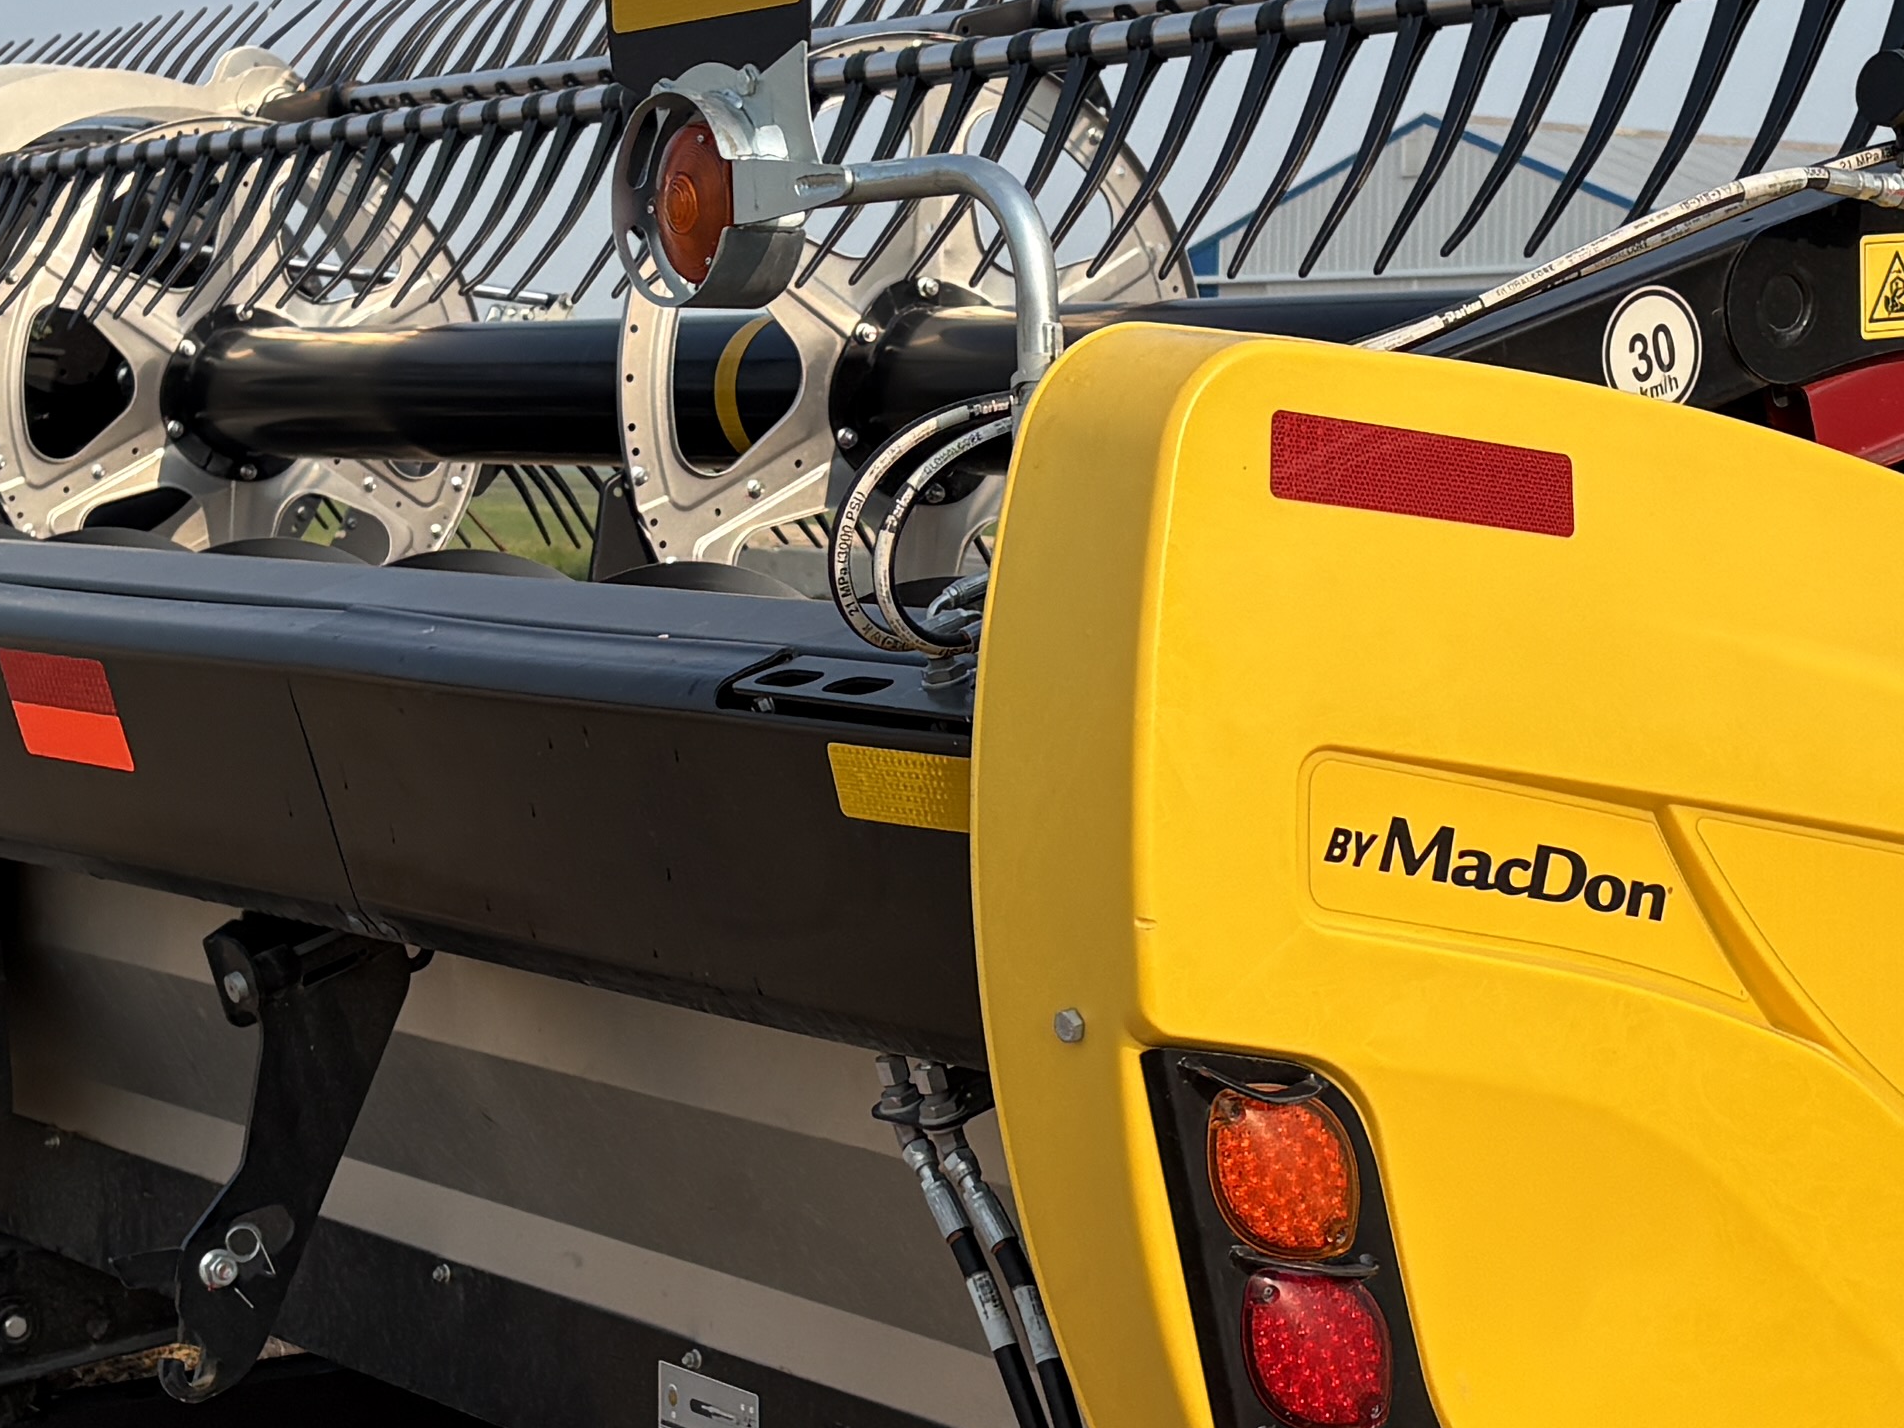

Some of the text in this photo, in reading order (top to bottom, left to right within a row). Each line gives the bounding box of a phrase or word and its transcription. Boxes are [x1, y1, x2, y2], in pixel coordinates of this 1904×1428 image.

[1856, 150, 1881, 169] MPa
[1628, 323, 1675, 383] 30
[837, 491, 865, 617] 21 MPa (3000 PSI)
[1323, 815, 1666, 922] BY MacDon
